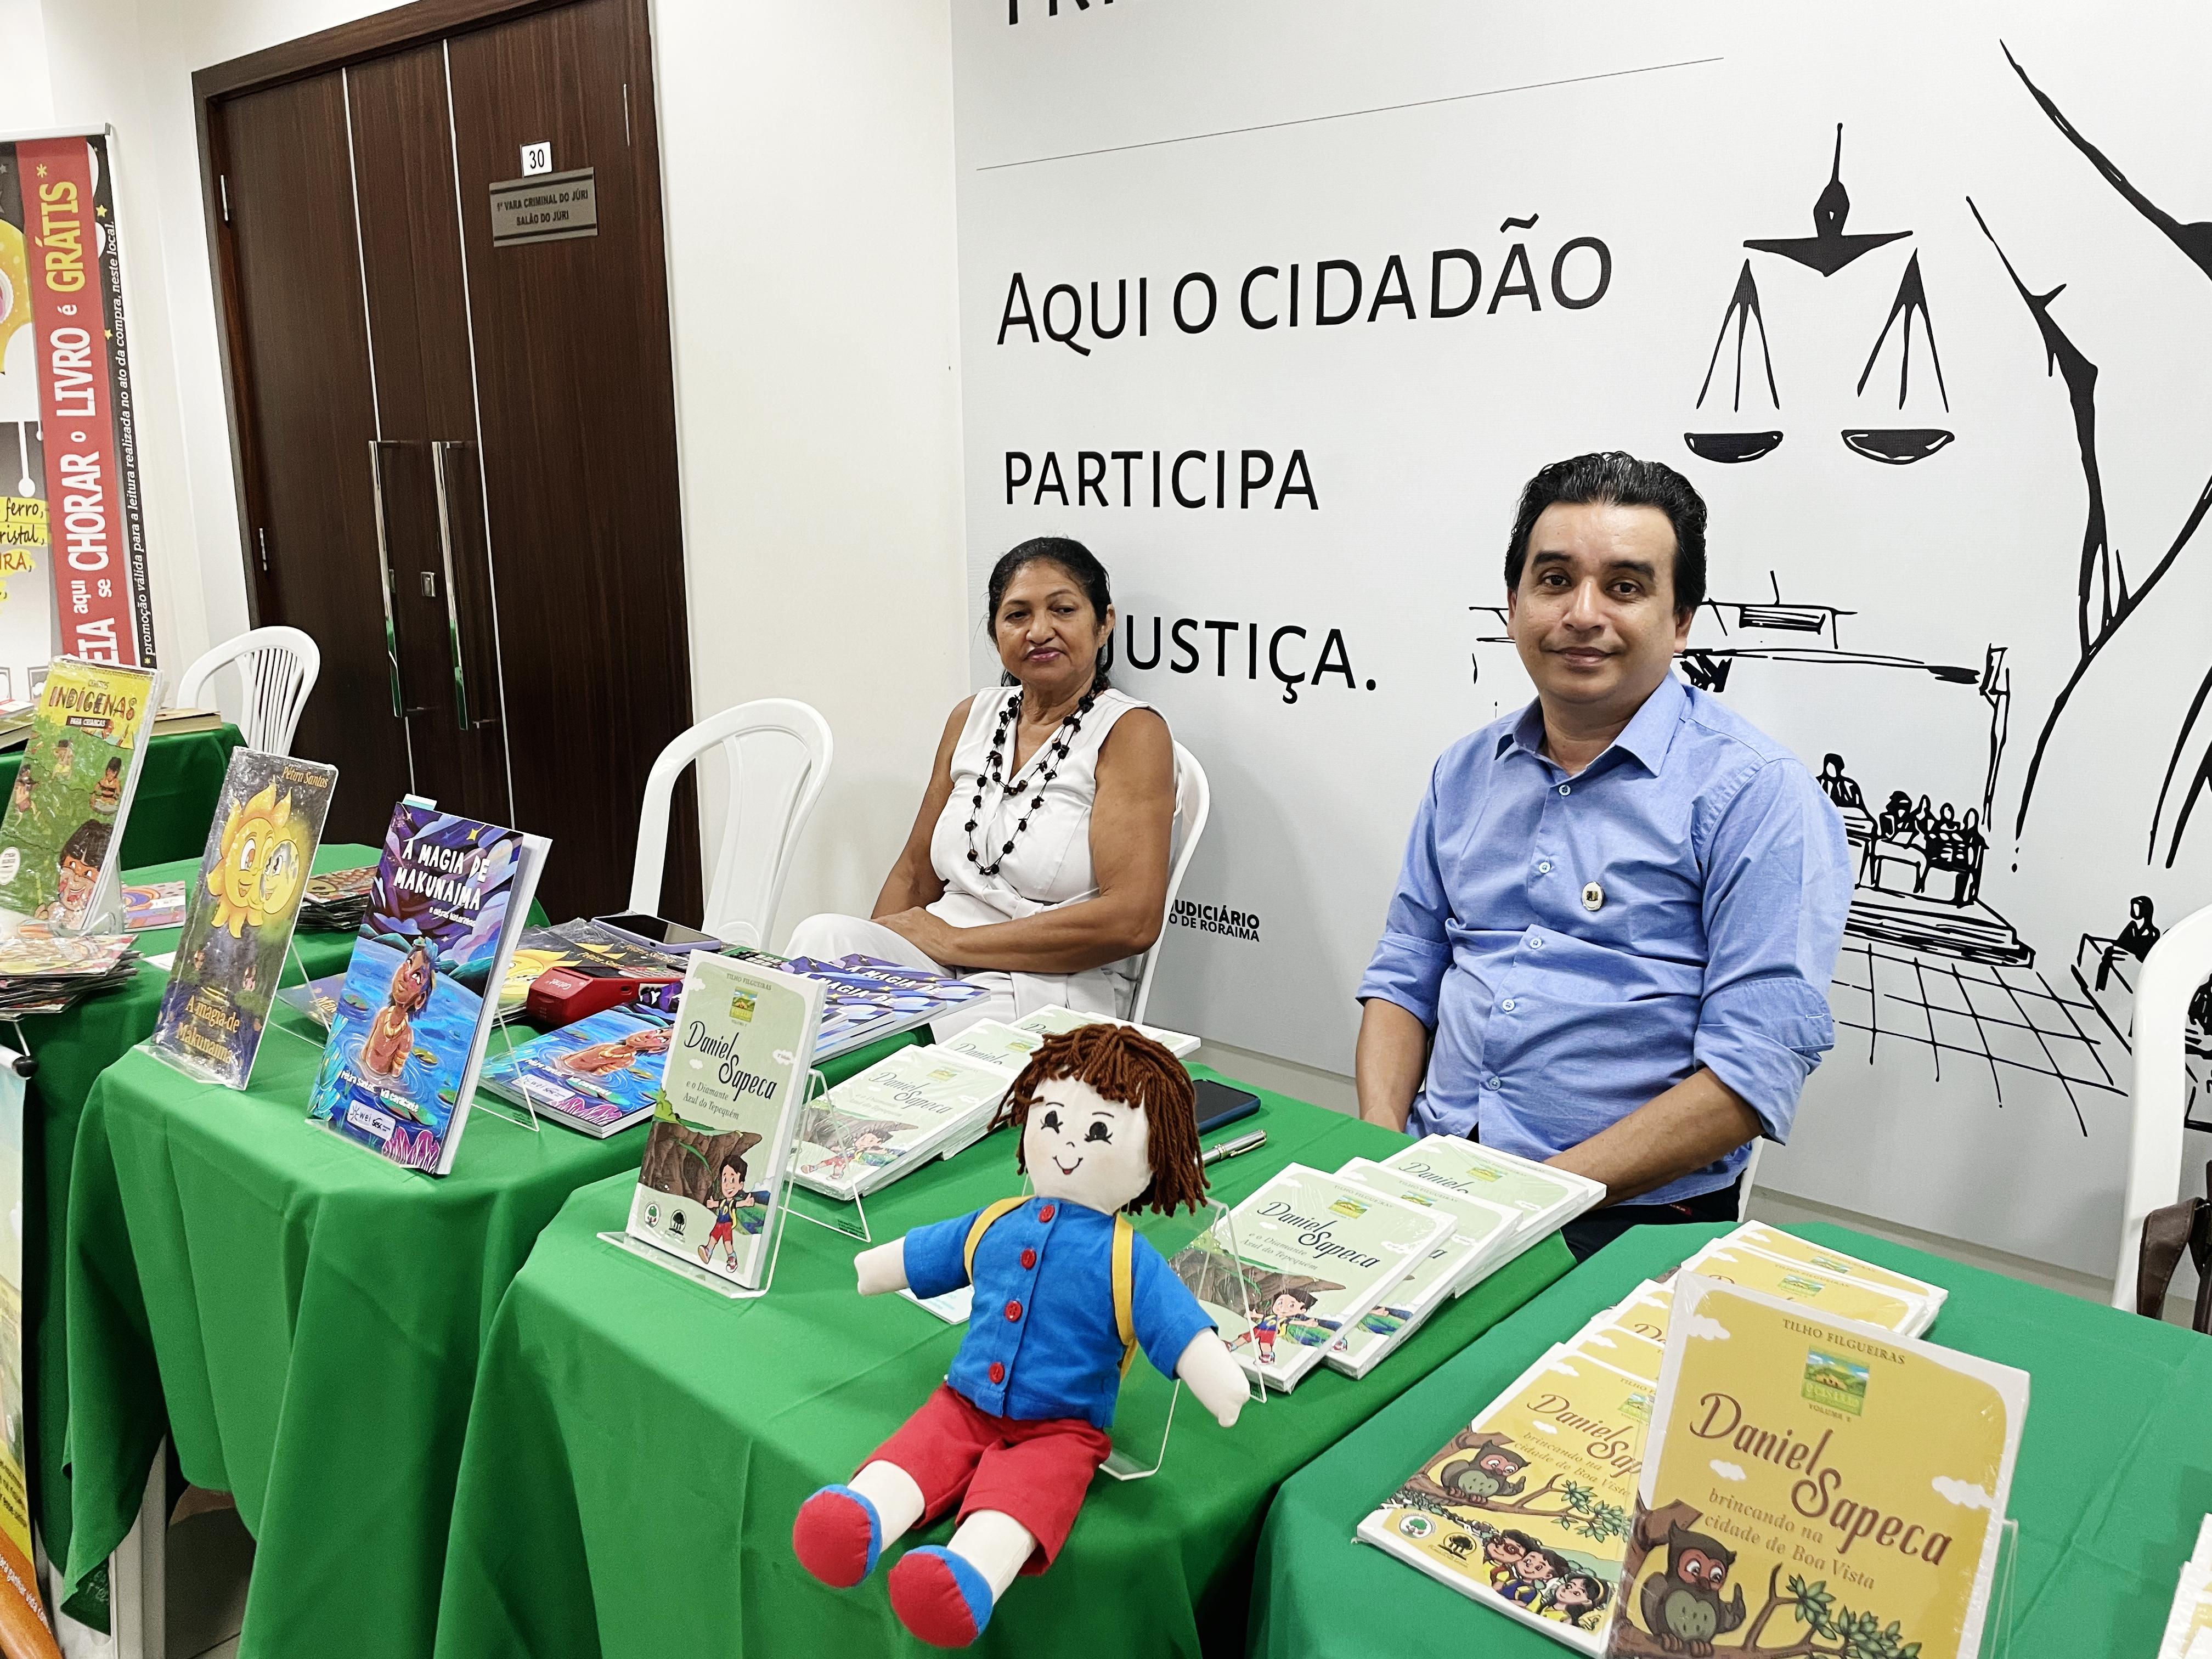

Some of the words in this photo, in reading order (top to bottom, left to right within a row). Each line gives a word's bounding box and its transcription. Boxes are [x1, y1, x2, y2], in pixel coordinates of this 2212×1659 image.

[529, 149, 545, 170] 30
[504, 198, 523, 211] VARA
[523, 195, 558, 208] CRIMINAL
[559, 192, 569, 203] DO
[571, 188, 589, 202] JÚRI
[516, 212, 539, 226] SALÃO
[540, 212, 551, 223] DO
[106, 221, 118, 256] local.
[110, 258, 121, 293] neste
[996, 272, 1147, 357] AQUI
[1172, 272, 1217, 335] O
[1239, 213, 1612, 330] CIDADÃO
[57, 304, 78, 316] é
[112, 292, 126, 348] compra,
[49, 327, 97, 417] LIVRO
[114, 349, 127, 365] da
[118, 369, 128, 390] ato
[120, 390, 129, 408] no
[70, 431, 87, 443] o
[119, 409, 135, 472] realizada
[126, 474, 138, 511] leitura
[1005, 449, 1319, 510] PARTICIPA
[5, 497, 44, 522] ferro,
[60, 451, 110, 572] CHORAR
[131, 511, 139, 521] a
[131, 523, 145, 553] para
[97, 578, 112, 598] se
[131, 552, 147, 592] válida
[71, 580, 88, 614] aqui
[137, 594, 157, 657] promoção
[48, 686, 138, 721] INDÍGENAS
[303, 772, 329, 789] Santos
[402, 836, 414, 860] A
[417, 843, 465, 876] MAGIA
[469, 854, 491, 883] DE
[392, 866, 482, 912] MAKUNAIMA
[1181, 915, 1197, 929] DE
[1200, 919, 1260, 943] RORAIMA
[726, 973, 742, 983] TILHO
[862, 969, 917, 988] MAGIA
[913, 984, 945, 996] DE
[185, 995, 195, 1013] A
[194, 1001, 228, 1028] magia
[225, 1011, 240, 1033] de
[871, 995, 900, 1007] DE
[684, 1020, 740, 1061] Daniel
[696, 1081, 730, 1101] Diamante
[718, 1054, 777, 1102] Sapeca
[868, 1071, 932, 1093] Daniel
[682, 1092, 699, 1106] Azul
[698, 1097, 708, 1109] do
[708, 1101, 740, 1120] Tepequém
[893, 1090, 954, 1115] Sapeca
[1398, 1161, 1476, 1190] Daniel
[1256, 1201, 1339, 1233] Daniel
[1239, 1238, 1263, 1250] Azul
[1262, 1245, 1276, 1255] do
[1263, 1237, 1308, 1256] Diamante
[1297, 1231, 1381, 1269] Sapeca
[1783, 1318, 1823, 1339] TILHO
[1826, 1331, 1906, 1365] FILGUEIRAS
[1620, 1377, 1648, 1391] TILHO
[1526, 1393, 1634, 1442] Daniel
[1689, 1391, 1833, 1477] Daniel
[1514, 1441, 1554, 1464] cidade
[1555, 1459, 1572, 1471] de
[1573, 1468, 1598, 1483] Boa
[1523, 1431, 1584, 1463] brincando
[1585, 1460, 1603, 1471] na
[1708, 1487, 1795, 1534] brincando
[1801, 1526, 1824, 1545] na
[1791, 1467, 1954, 1568] Sapeca
[1703, 1513, 1762, 1547] cidade
[1765, 1534, 1787, 1556] de
[1793, 1544, 1826, 1573] Boa
[1832, 1559, 1876, 1591] Vista
